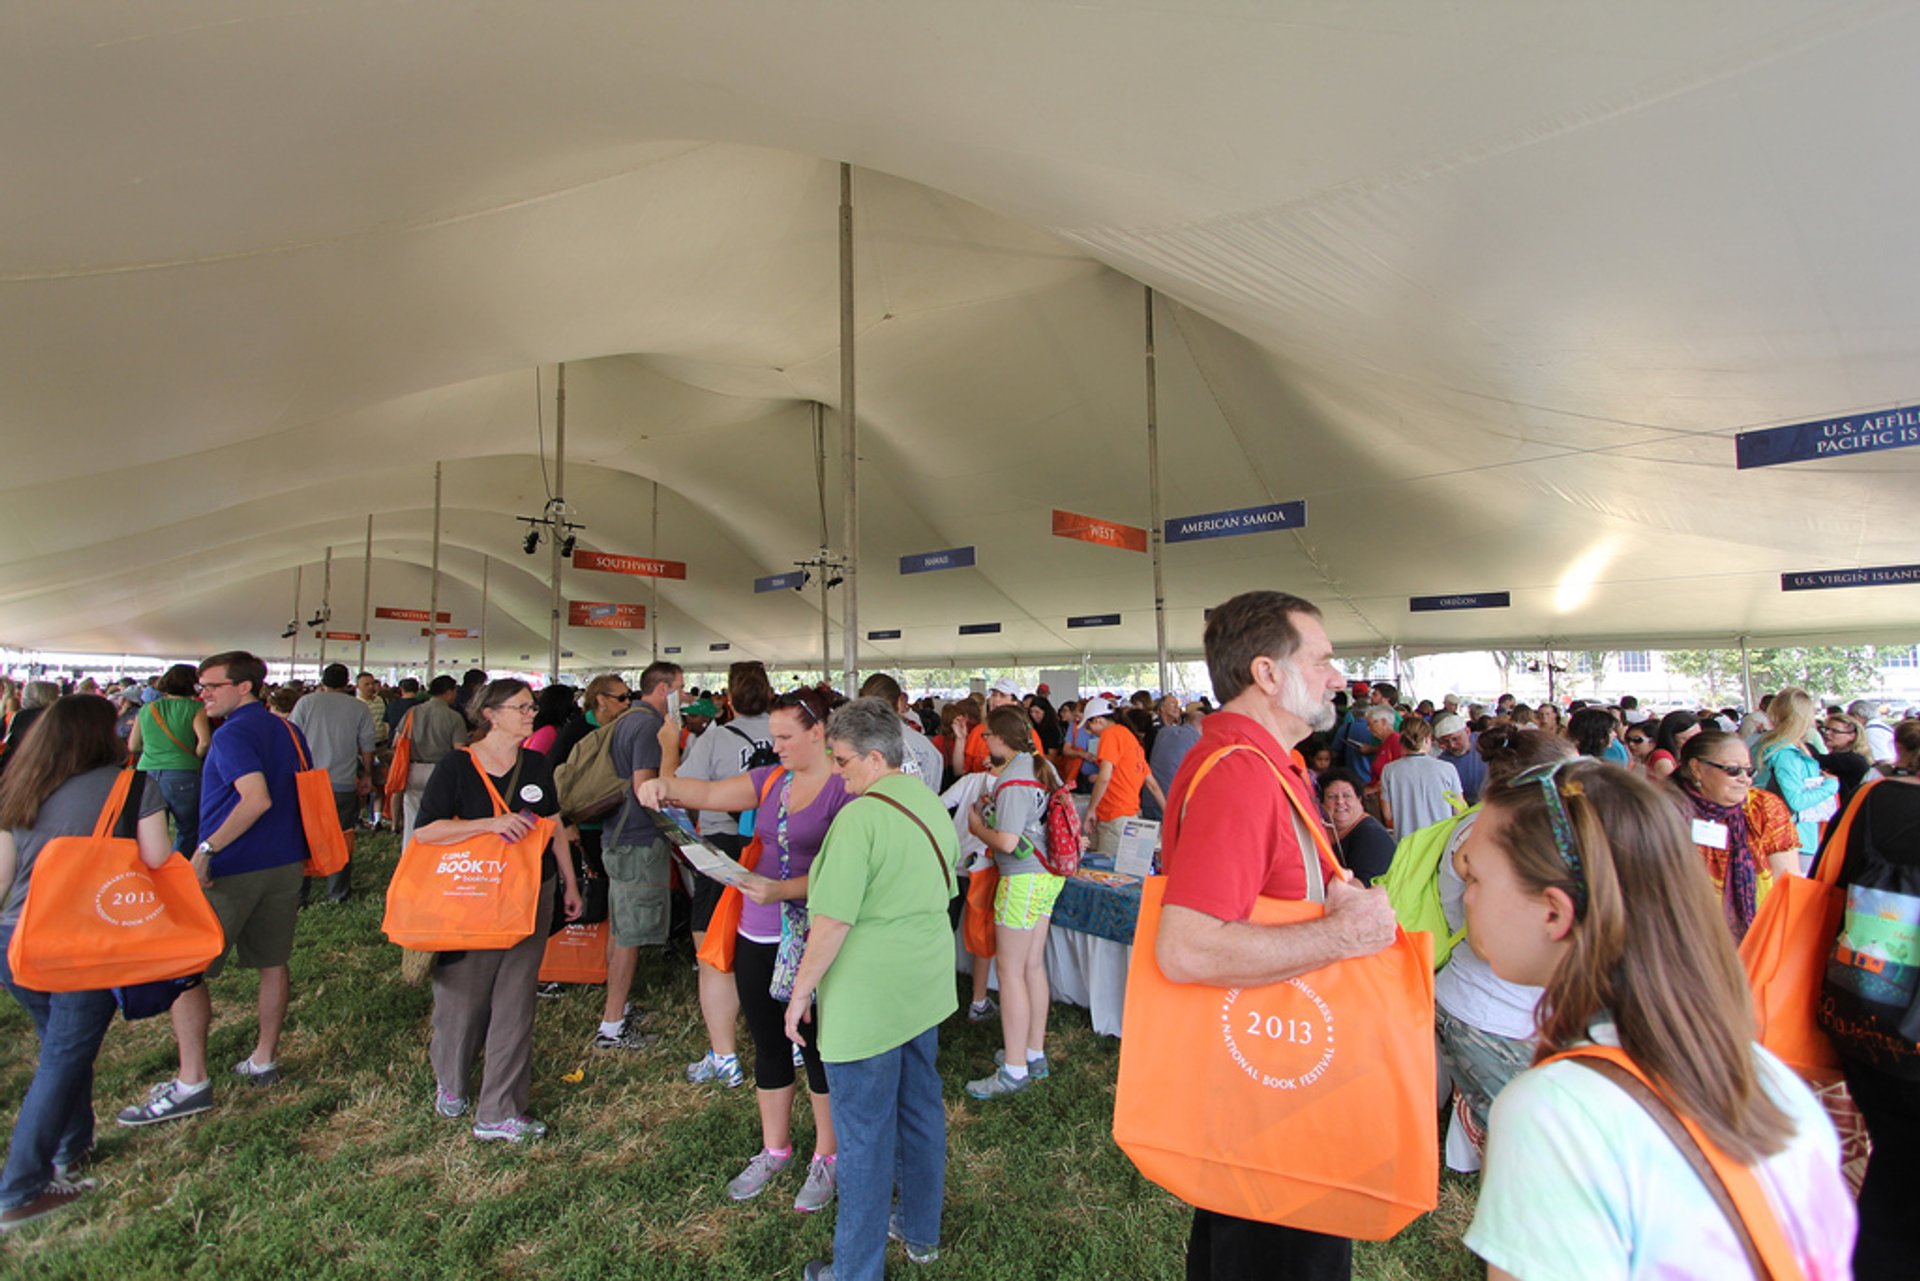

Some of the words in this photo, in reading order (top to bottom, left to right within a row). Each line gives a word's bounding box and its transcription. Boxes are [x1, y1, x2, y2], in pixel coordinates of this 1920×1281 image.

[1823, 420, 1857, 438] U.S.
[1816, 431, 1894, 453] PACIFIC
[1180, 519, 1239, 534] AMERICAN
[1243, 511, 1285, 526] SAMOA
[1089, 525, 1116, 541] WEST
[596, 556, 666, 573] SOUTHWEST
[1794, 574, 1816, 586] U.S.
[1819, 571, 1869, 584] VIRGIN
[1440, 597, 1477, 606] OREGON
[436, 859, 485, 874] BOOK
[485, 860, 509, 873] TV
[112, 891, 156, 906] 2013
[1284, 976, 1335, 1024] ONGRESS
[1246, 1010, 1314, 1045] 2013
[1222, 1023, 1260, 1081] NATIONAL
[1261, 1074, 1298, 1091] BOOK
[1299, 1047, 1336, 1087] FESTIVAL
